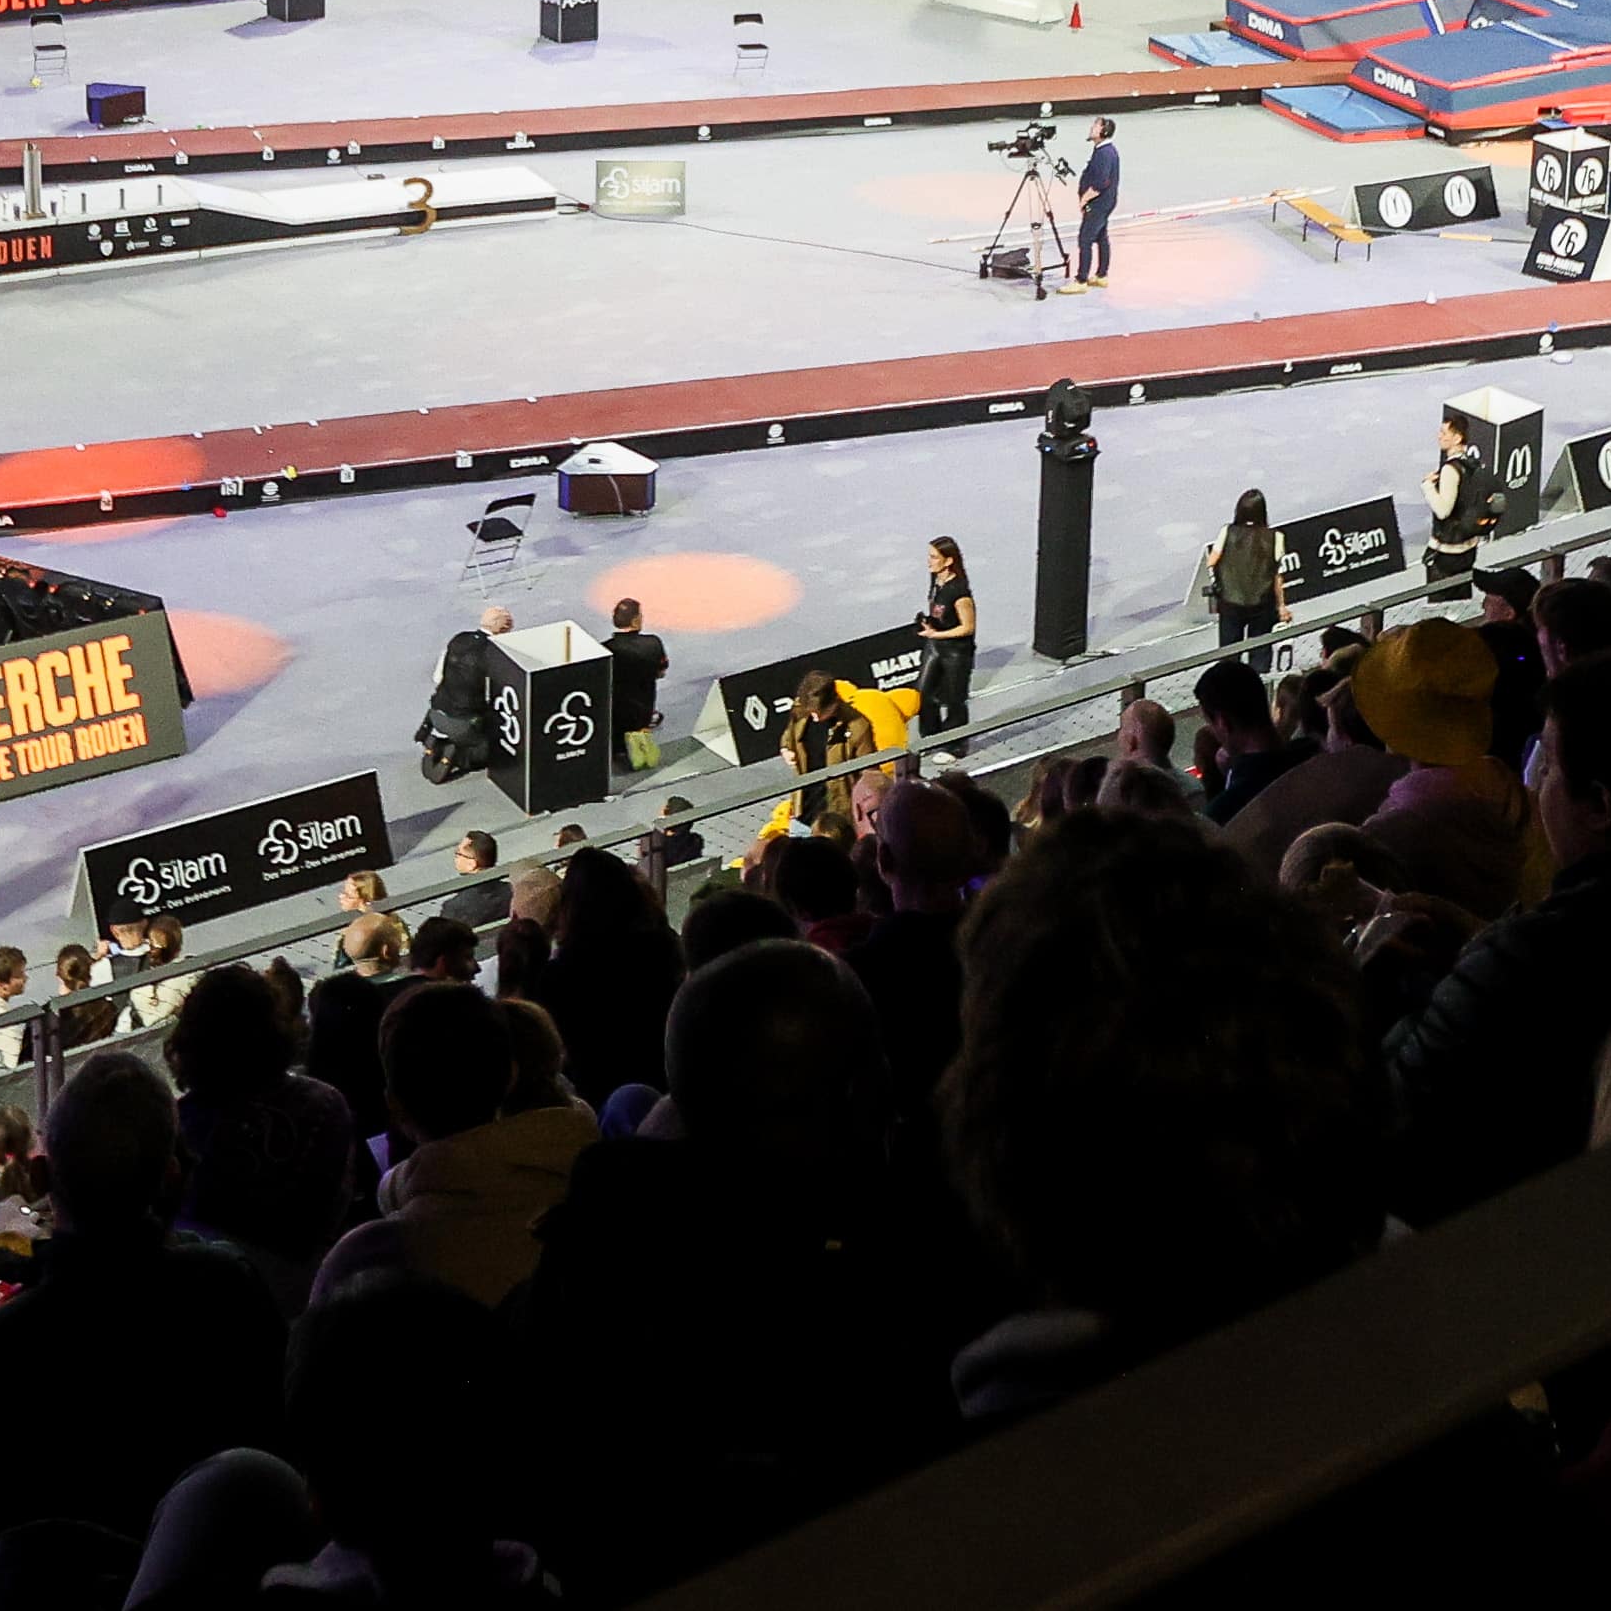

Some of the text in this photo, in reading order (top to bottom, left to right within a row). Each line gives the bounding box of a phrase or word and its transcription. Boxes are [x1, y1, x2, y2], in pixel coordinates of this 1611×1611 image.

[1247, 12, 1286, 41] DIMA
[1373, 67, 1418, 99] DIMA
[403, 177, 437, 236] 3
[1560, 224, 1578, 257] 76
[1345, 527, 1387, 557] silam
[870, 649, 922, 679] MARY
[12, 730, 76, 776] TOUR
[73, 712, 150, 762] ROUEN
[298, 814, 363, 851] silam
[160, 852, 227, 889] silam
